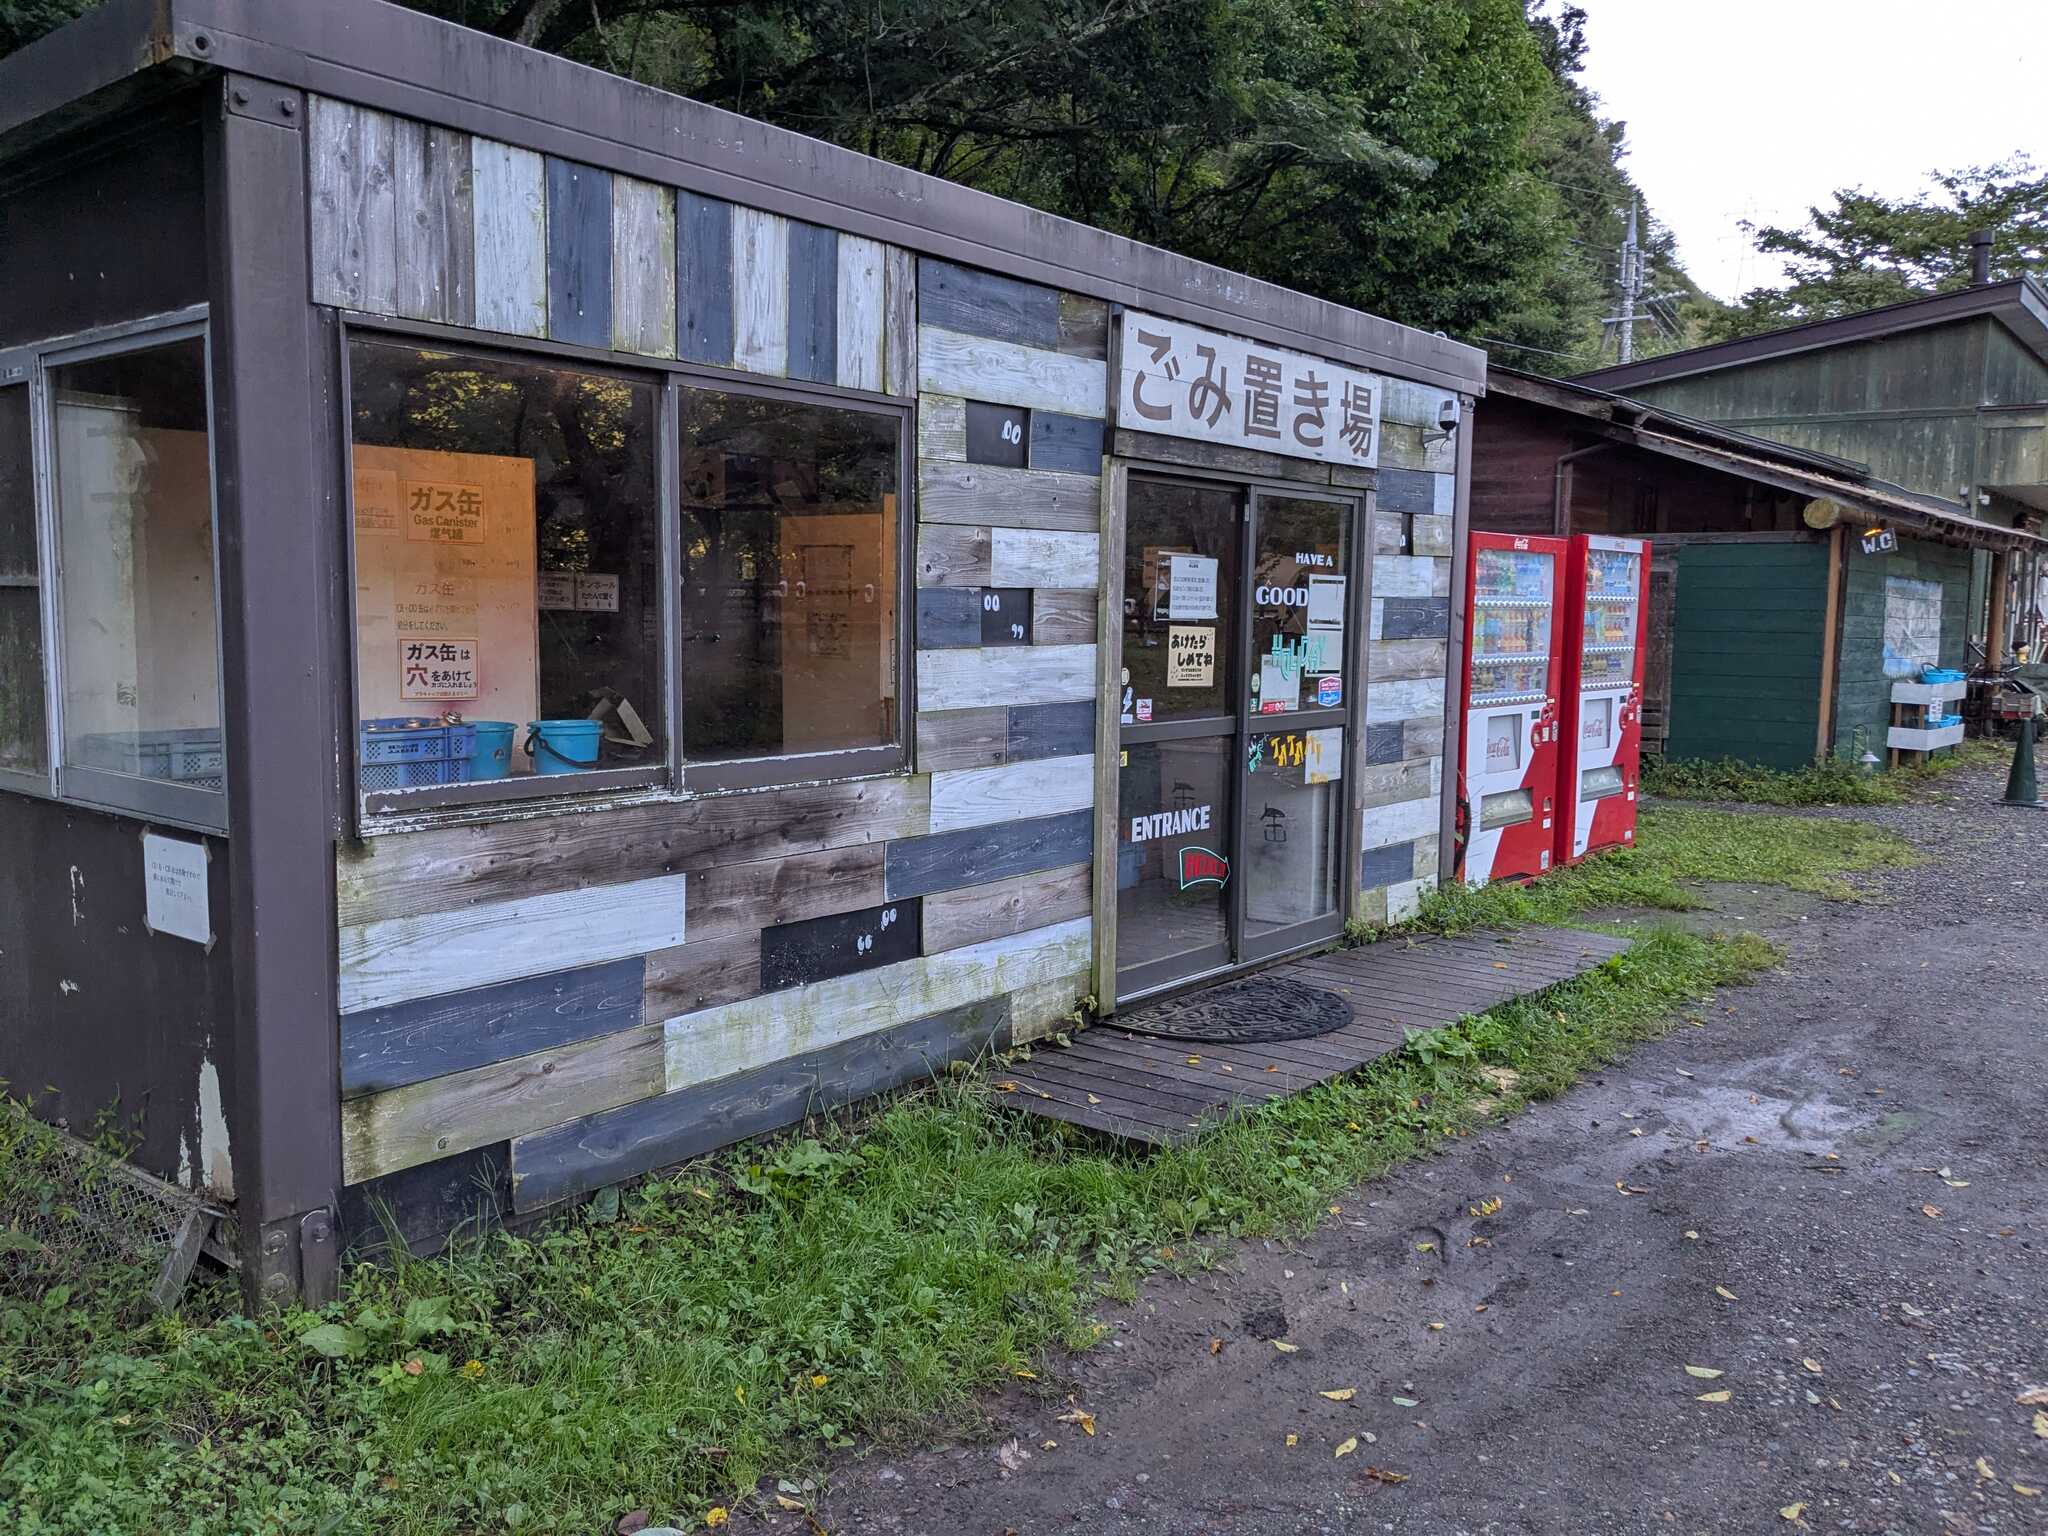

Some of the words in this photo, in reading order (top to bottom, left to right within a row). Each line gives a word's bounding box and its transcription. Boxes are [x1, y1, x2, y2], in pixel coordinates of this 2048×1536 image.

[1132, 328, 1374, 458] ごみ置き場
[409, 486, 482, 517] ガス缶
[414, 513, 434, 526] Gas
[436, 515, 478, 528] Canister
[1295, 552, 1325, 566] HAVE
[1325, 555, 1334, 567] A
[415, 583, 455, 597] ガス缶
[1255, 586, 1309, 607] GOOD
[1170, 634, 1208, 650] あけたら
[406, 643, 472, 662] ガス缶は
[1177, 652, 1214, 667] しめてね
[406, 664, 472, 687] 穴をあけて
[1131, 804, 1211, 843] ENTRANCE
